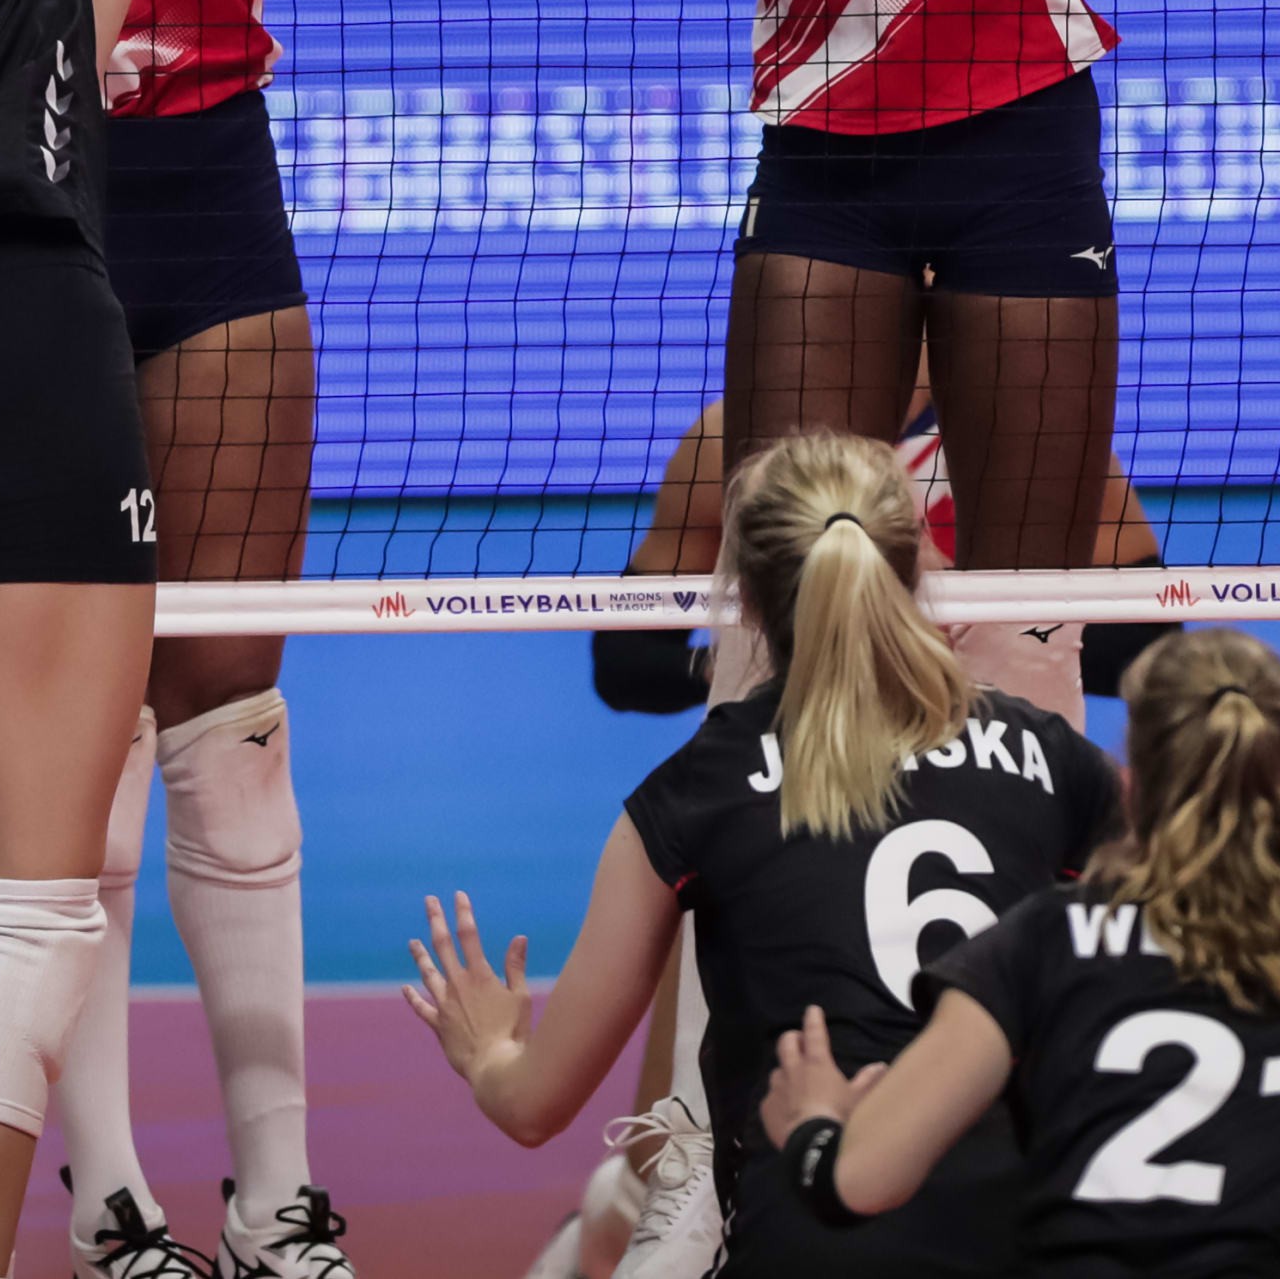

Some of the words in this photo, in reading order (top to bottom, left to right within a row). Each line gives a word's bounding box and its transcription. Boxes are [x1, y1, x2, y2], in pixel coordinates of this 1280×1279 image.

[120, 487, 157, 543] 12
[371, 591, 417, 619] VNL
[426, 594, 605, 615] VOLLEYBALL
[609, 592, 663, 602] NATIONS
[609, 603, 656, 612] LEAGUE
[1156, 579, 1200, 608] VNL
[747, 718, 1055, 795] JSKA
[864, 819, 1000, 1013] 6
